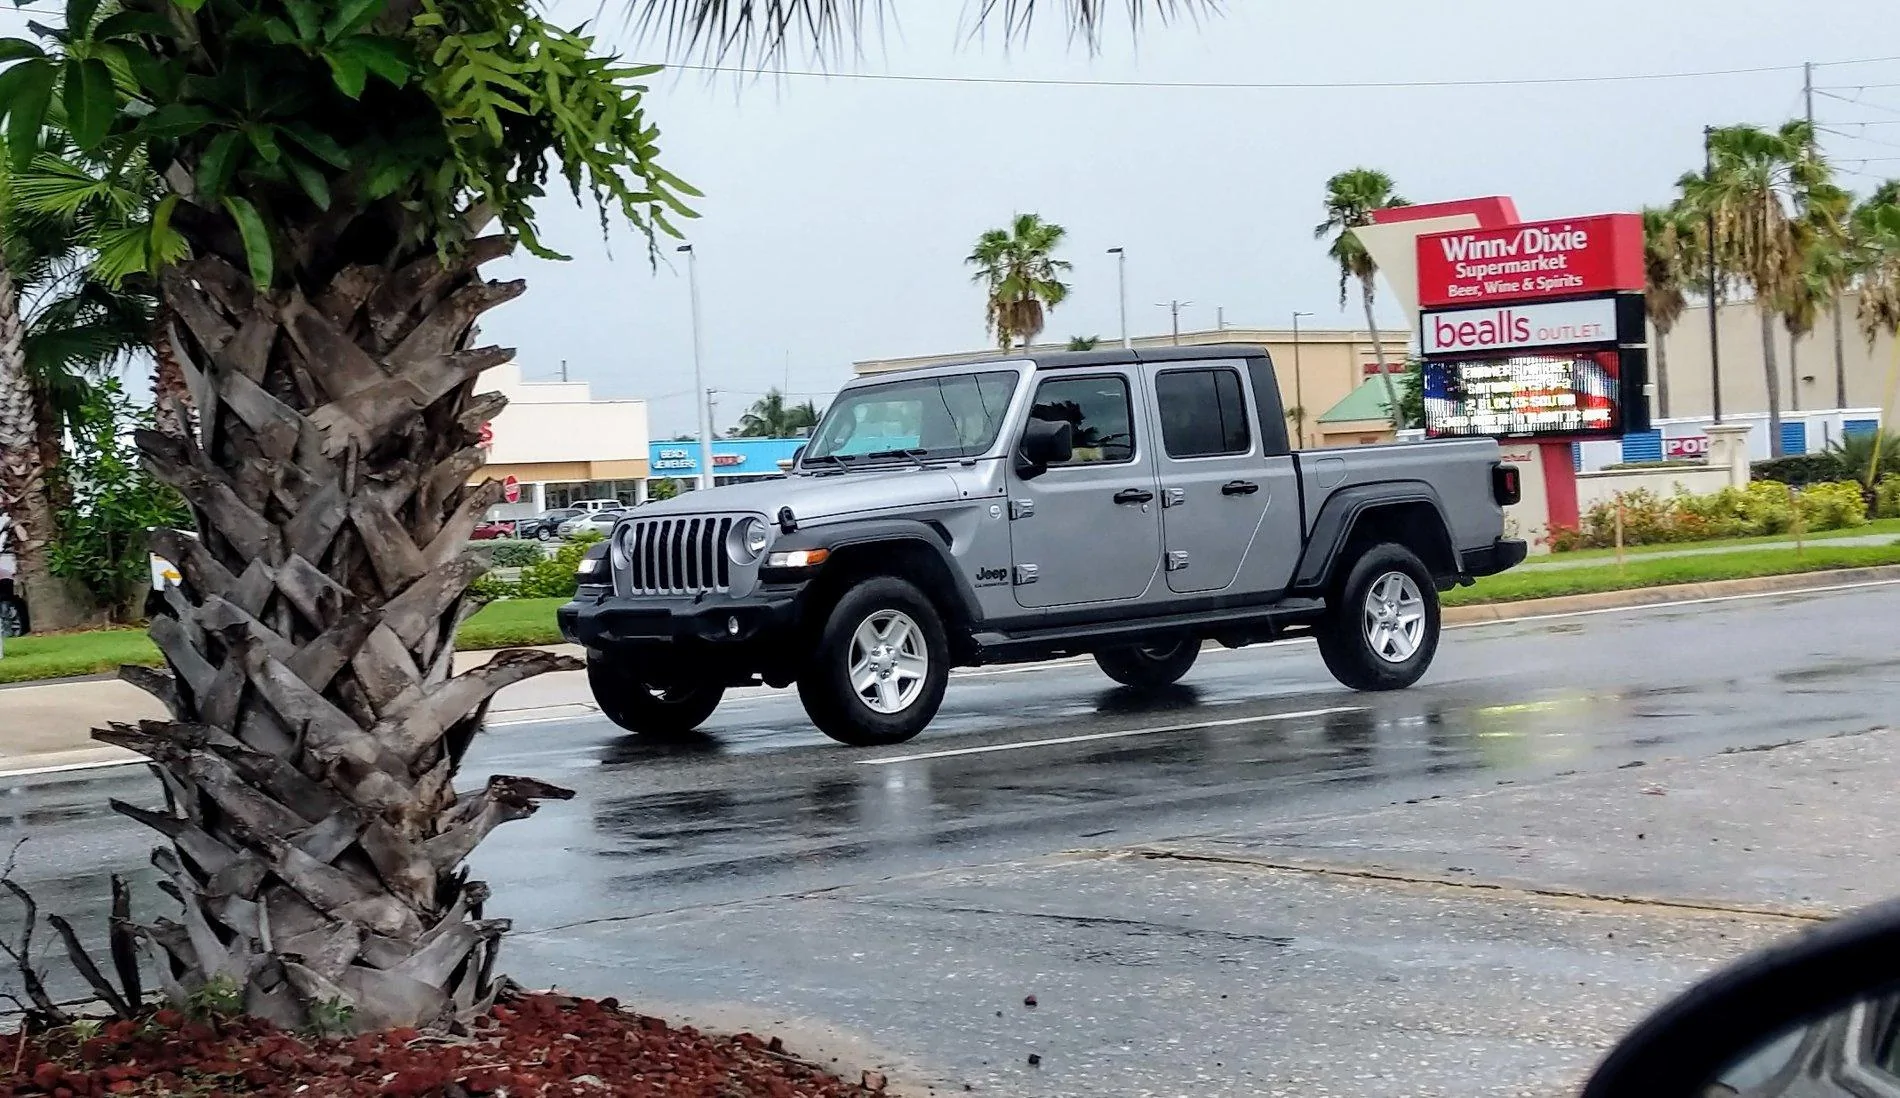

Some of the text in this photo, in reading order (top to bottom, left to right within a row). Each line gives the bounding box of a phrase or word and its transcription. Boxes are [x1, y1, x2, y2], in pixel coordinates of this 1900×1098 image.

[1440, 225, 1588, 262] Winn Dixie
[1455, 253, 1568, 280] Supermarket
[1447, 274, 1584, 298] Beer, Wine & Spirits
[1434, 310, 1602, 348] bealls OUTLET
[976, 566, 1008, 581] Jeep
